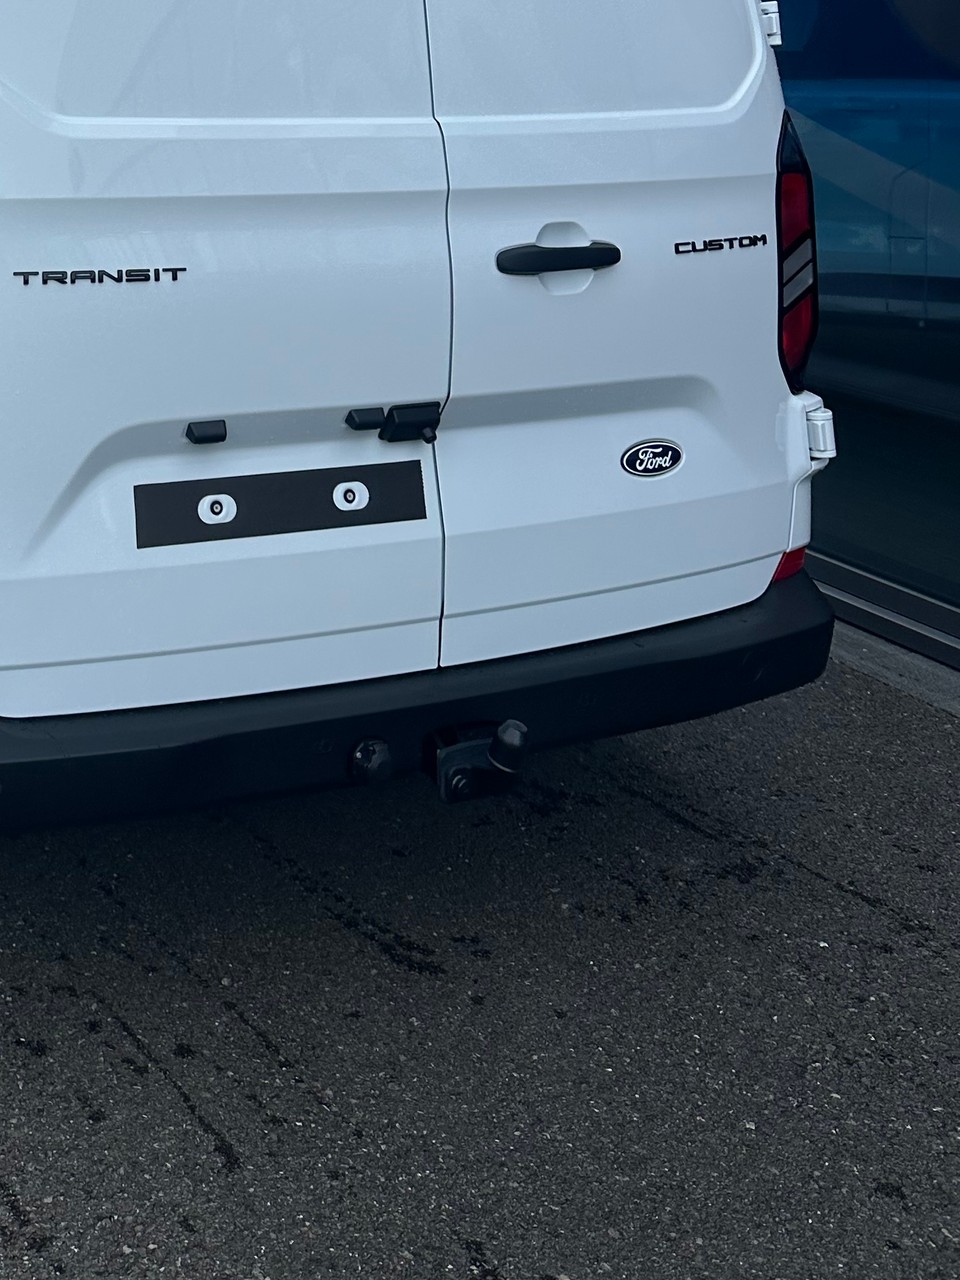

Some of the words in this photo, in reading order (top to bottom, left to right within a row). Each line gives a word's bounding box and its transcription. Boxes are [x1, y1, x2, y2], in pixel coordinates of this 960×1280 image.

[674, 234, 768, 255] CUSTOM
[12, 267, 187, 286] TRANSIT
[635, 447, 673, 470] Ford
